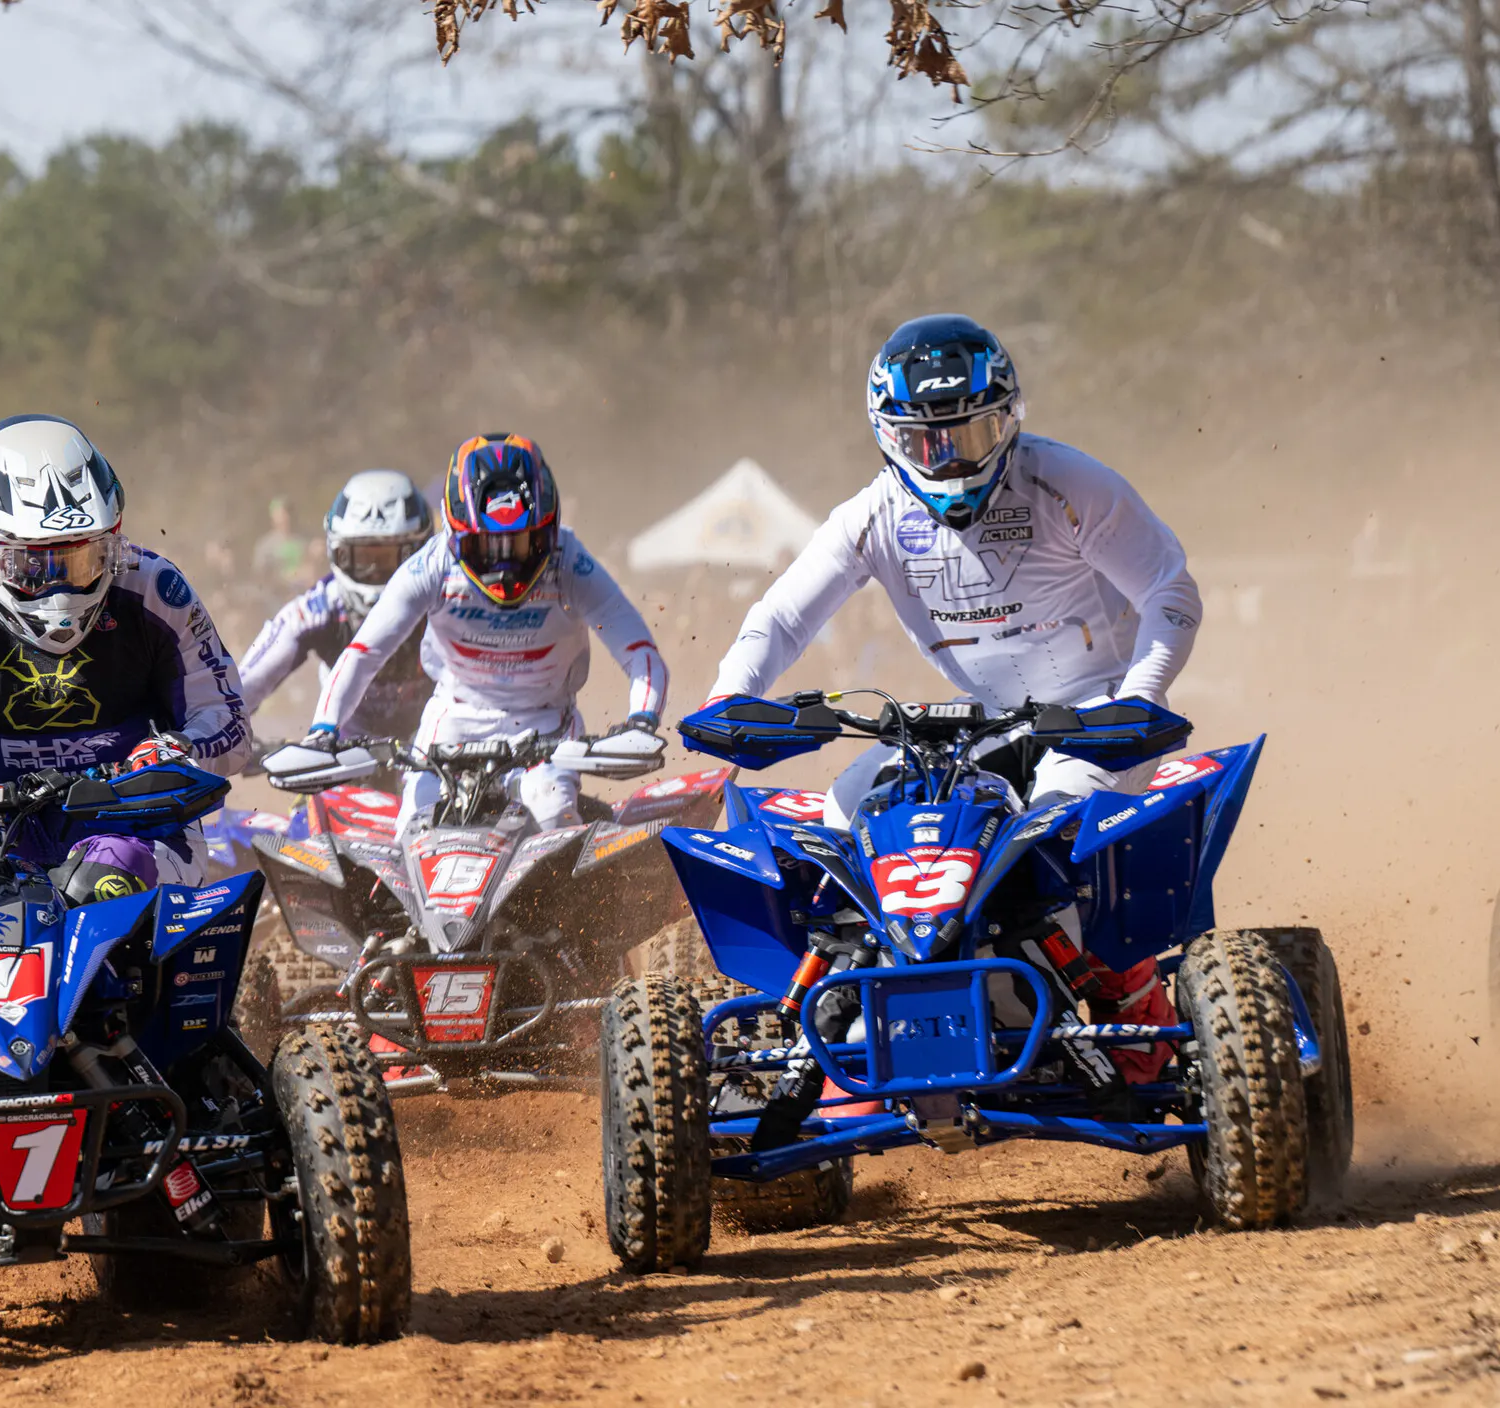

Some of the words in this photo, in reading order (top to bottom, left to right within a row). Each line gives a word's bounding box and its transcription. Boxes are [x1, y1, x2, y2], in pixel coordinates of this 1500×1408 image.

[916, 376, 967, 394] FLY
[41, 505, 95, 531] 6D
[980, 527, 1030, 544] ACTION
[3, 753, 97, 769] RACING
[1150, 760, 1198, 787] 3
[429, 853, 494, 895] 15
[881, 859, 973, 914] 3
[200, 924, 242, 937] KENDA
[425, 971, 490, 1015] 15
[11, 1123, 69, 1203] 1
[174, 1189, 213, 1222] Elka
